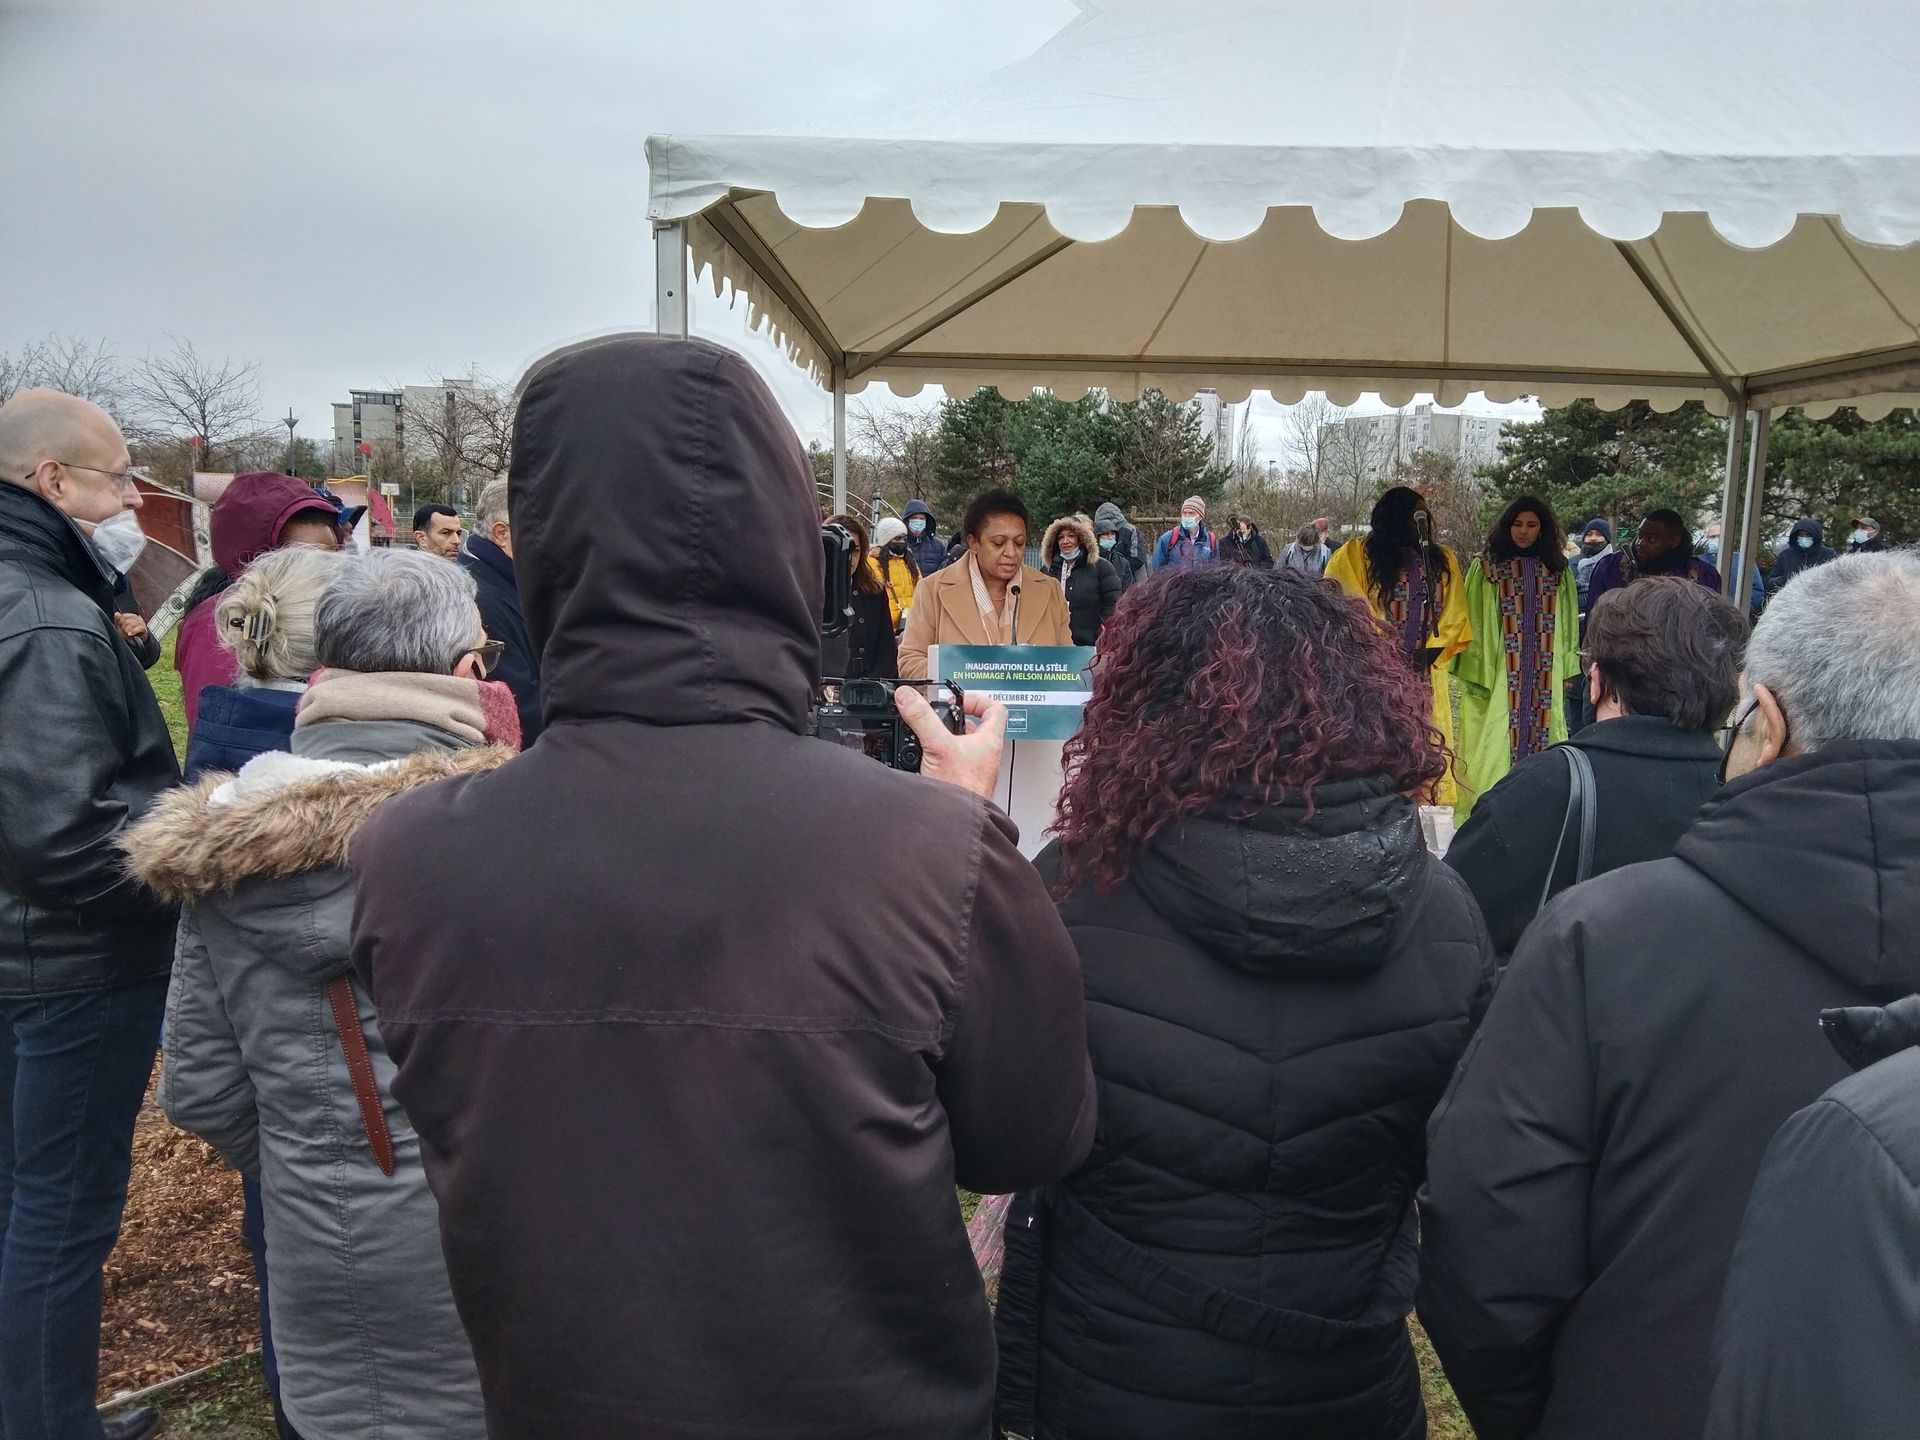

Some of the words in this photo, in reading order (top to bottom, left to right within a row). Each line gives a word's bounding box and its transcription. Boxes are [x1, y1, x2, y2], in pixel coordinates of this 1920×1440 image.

[965, 662, 1022, 671] INAUGURATION
[1023, 663, 1033, 671] DE
[1046, 662, 1068, 671] STÈLE
[953, 671, 963, 679] EN
[965, 672, 1004, 680] HOMMAGE
[1006, 671, 1011, 680] À
[1012, 672, 1042, 680] NELSON
[1044, 673, 1081, 681] MANDELA
[993, 692, 1029, 701] DÉCEMBRE
